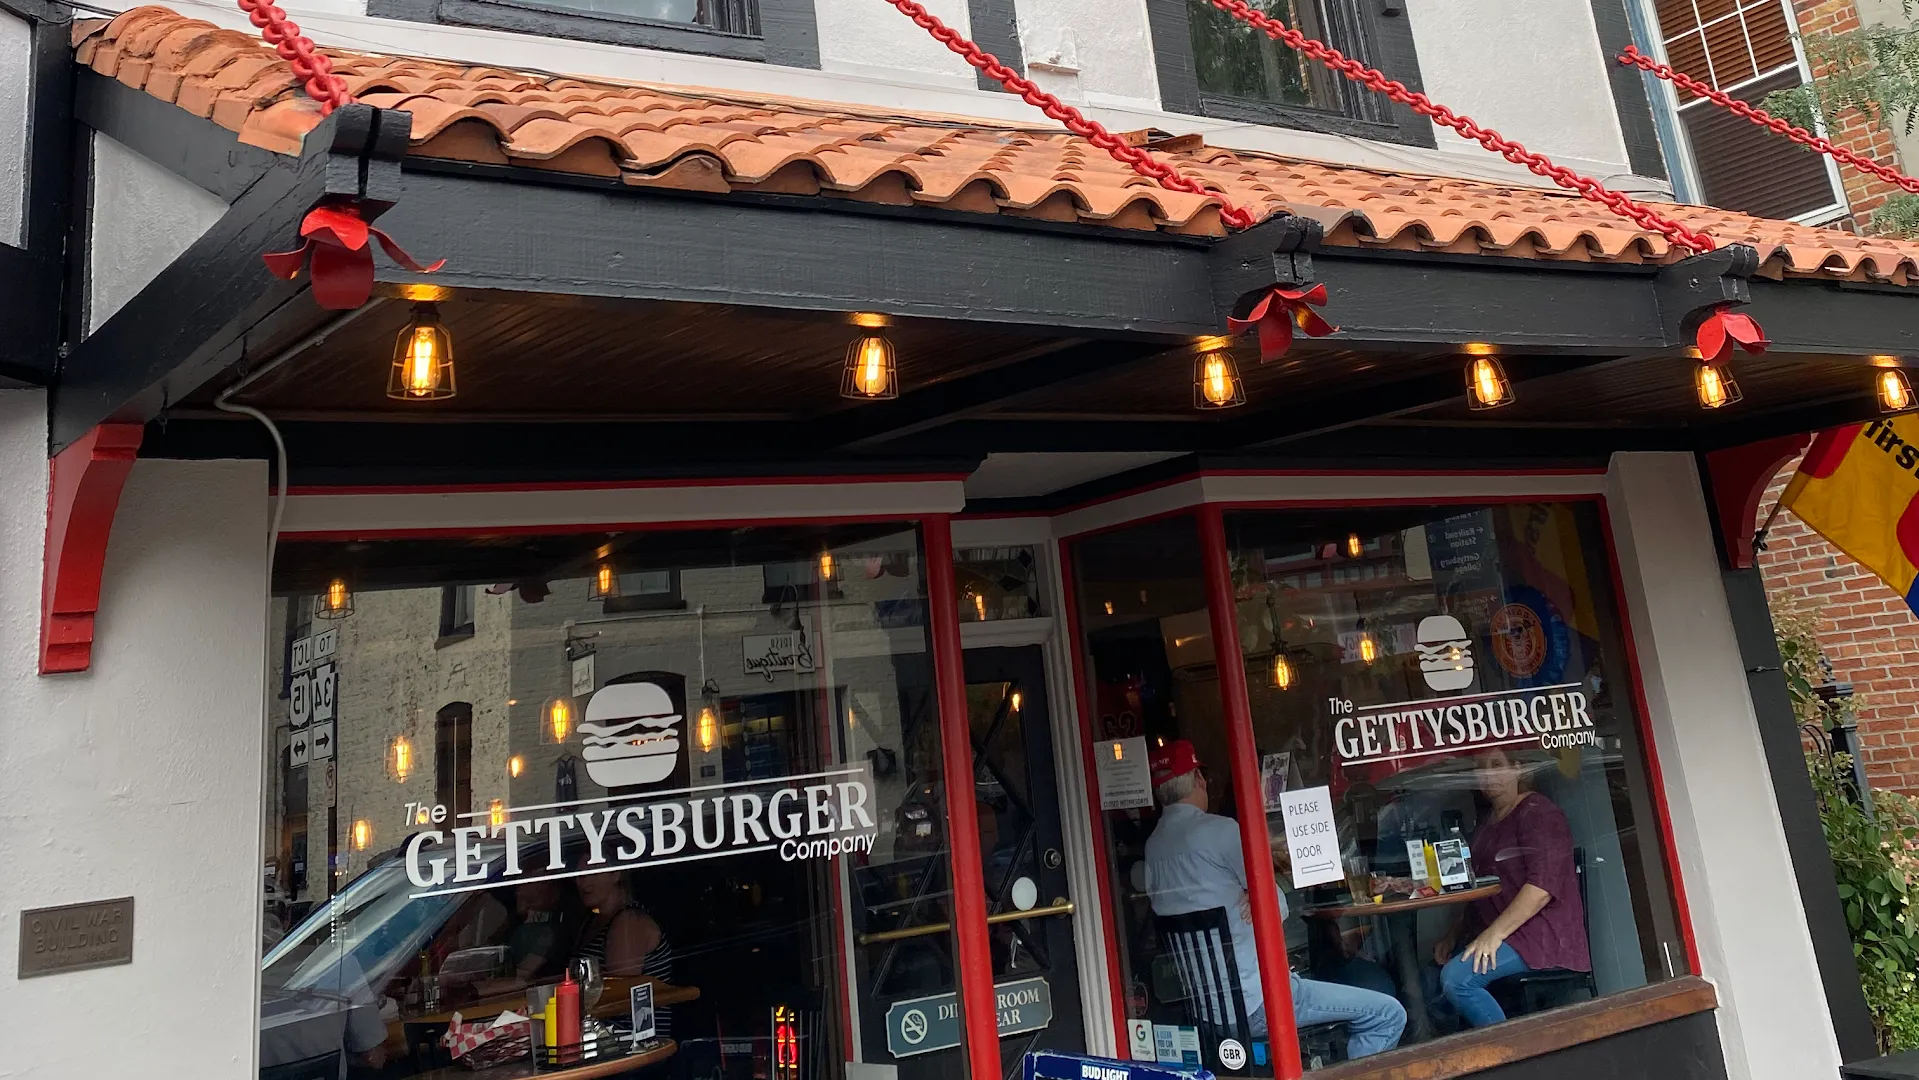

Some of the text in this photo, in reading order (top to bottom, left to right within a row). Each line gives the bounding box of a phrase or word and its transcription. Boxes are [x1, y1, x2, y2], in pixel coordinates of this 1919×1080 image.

[1863, 419, 1919, 480] firs
[1329, 697, 1353, 715] The
[1334, 691, 1594, 759] GETTYSBURGER
[1541, 729, 1596, 750] Company
[404, 802, 447, 826] The
[1289, 801, 1320, 817] PLEASE
[405, 781, 875, 888] GETTYSBURGER
[1292, 821, 1330, 838] USE SIDE
[780, 833, 877, 862] Company
[1296, 844, 1323, 859] DOOR
[32, 908, 123, 935] CIVIL WAR
[35, 928, 119, 954] BUILDING
[997, 988, 1040, 1009] ROOM
[996, 1009, 1021, 1027] EAR
[1223, 1048, 1242, 1060] GBR
[1081, 1065, 1129, 1080] BUD LIGHT
